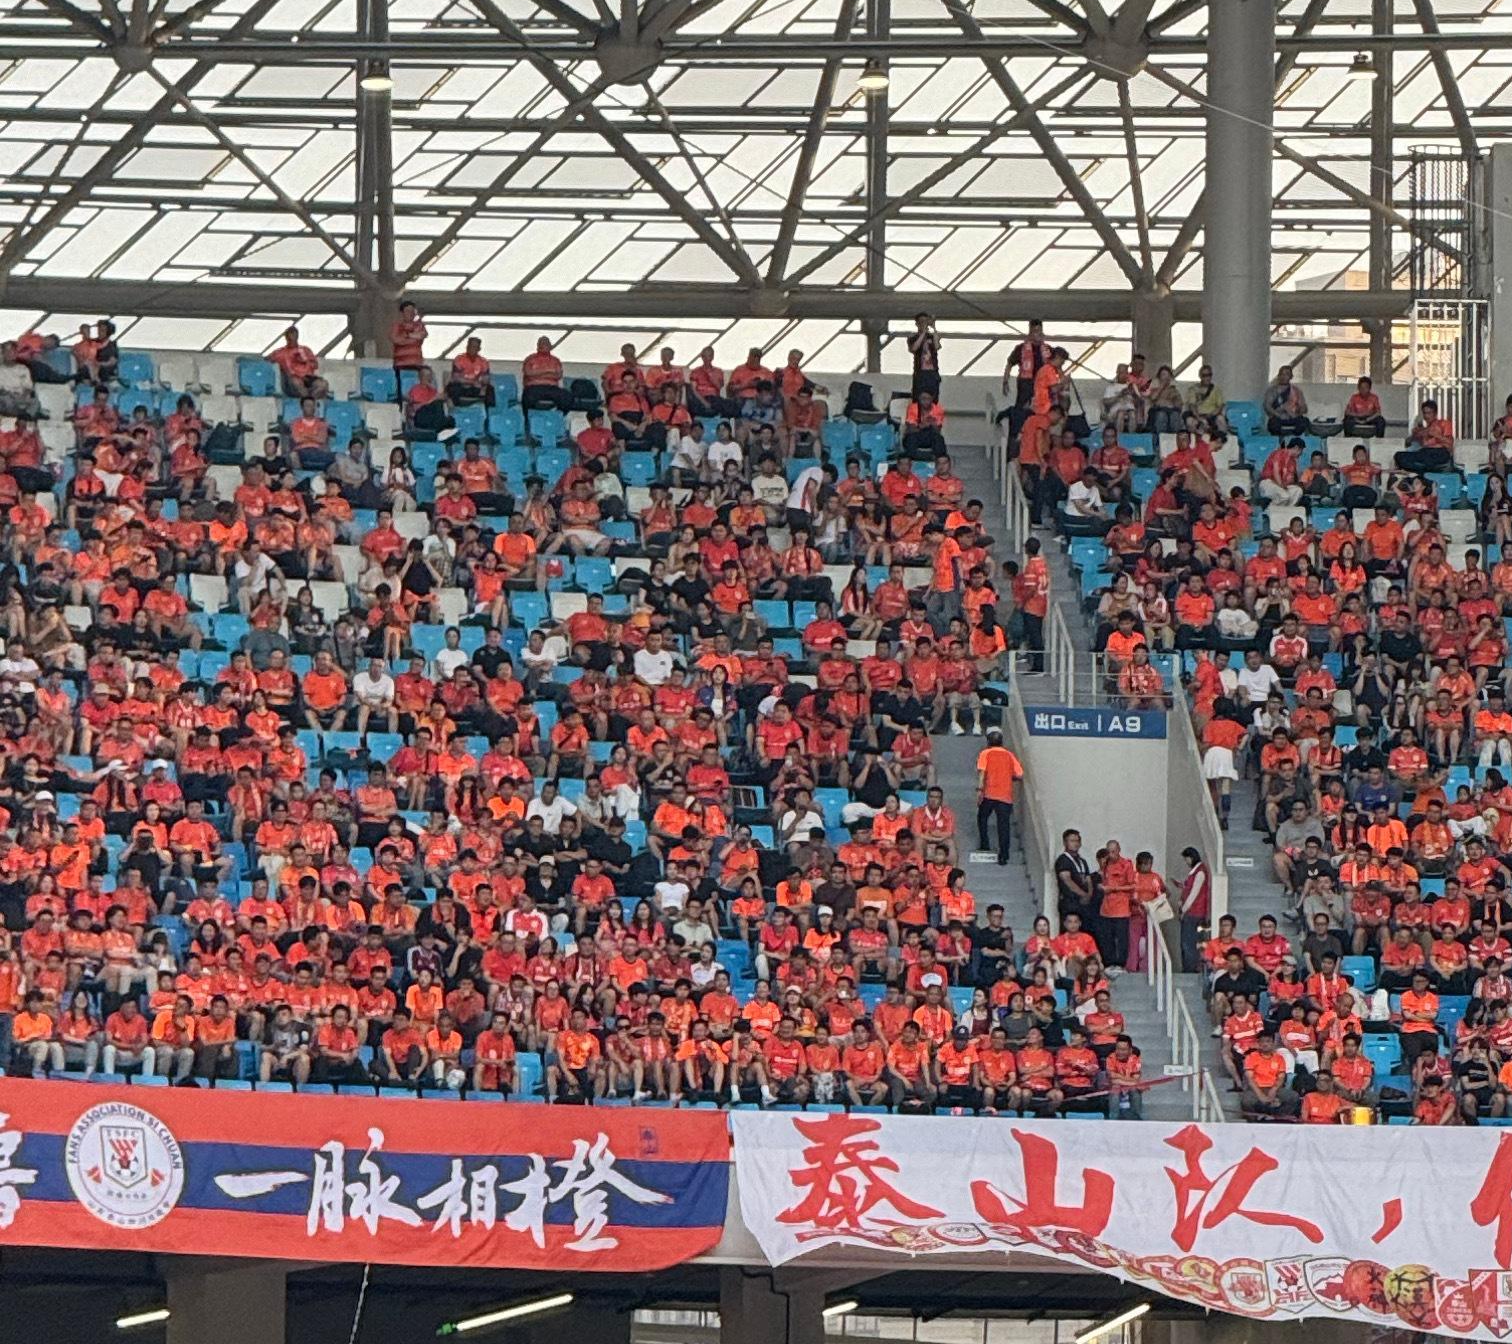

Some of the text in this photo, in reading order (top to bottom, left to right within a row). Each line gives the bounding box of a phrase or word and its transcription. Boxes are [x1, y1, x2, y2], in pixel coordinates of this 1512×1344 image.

[1034, 712, 1141, 733] 出口 Exit A9
[66, 1133, 83, 1165] FANS
[78, 1104, 151, 1136] ASSOCIATION
